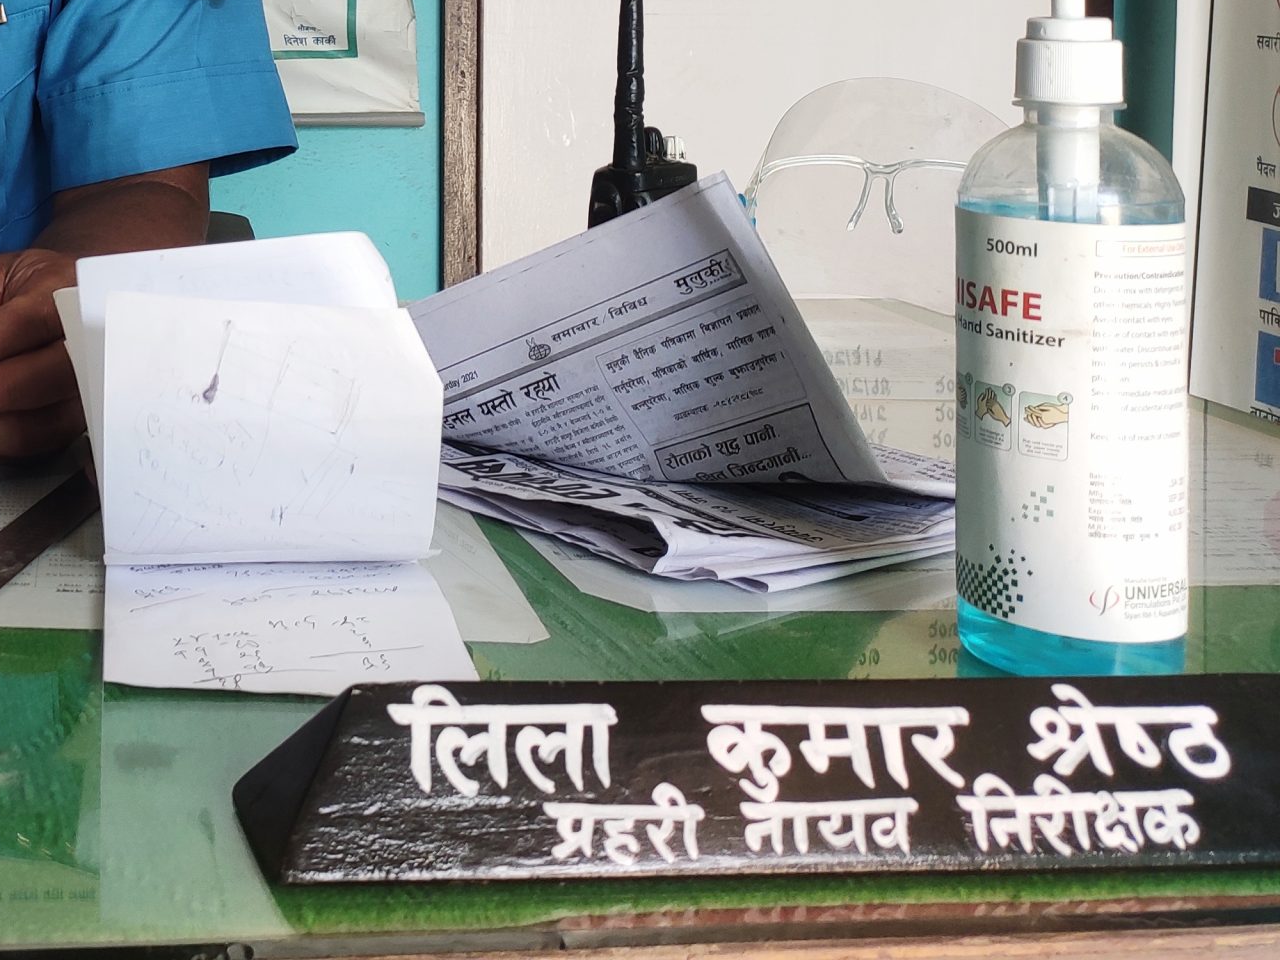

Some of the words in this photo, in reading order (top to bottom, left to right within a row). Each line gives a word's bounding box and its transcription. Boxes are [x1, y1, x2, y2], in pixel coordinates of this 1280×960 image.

[986, 238, 1038, 257] 500ml
[986, 323, 1066, 347] Sanitizer
[460, 370, 479, 384] 2021
[477, 389, 518, 417] यस्तो
[388, 685, 617, 797] लिला
[702, 705, 969, 802] कुमार
[1027, 683, 1232, 778] श्रेष्ठ
[543, 784, 703, 865] प्रहरी
[959, 774, 1201, 857] निरीक्षक
